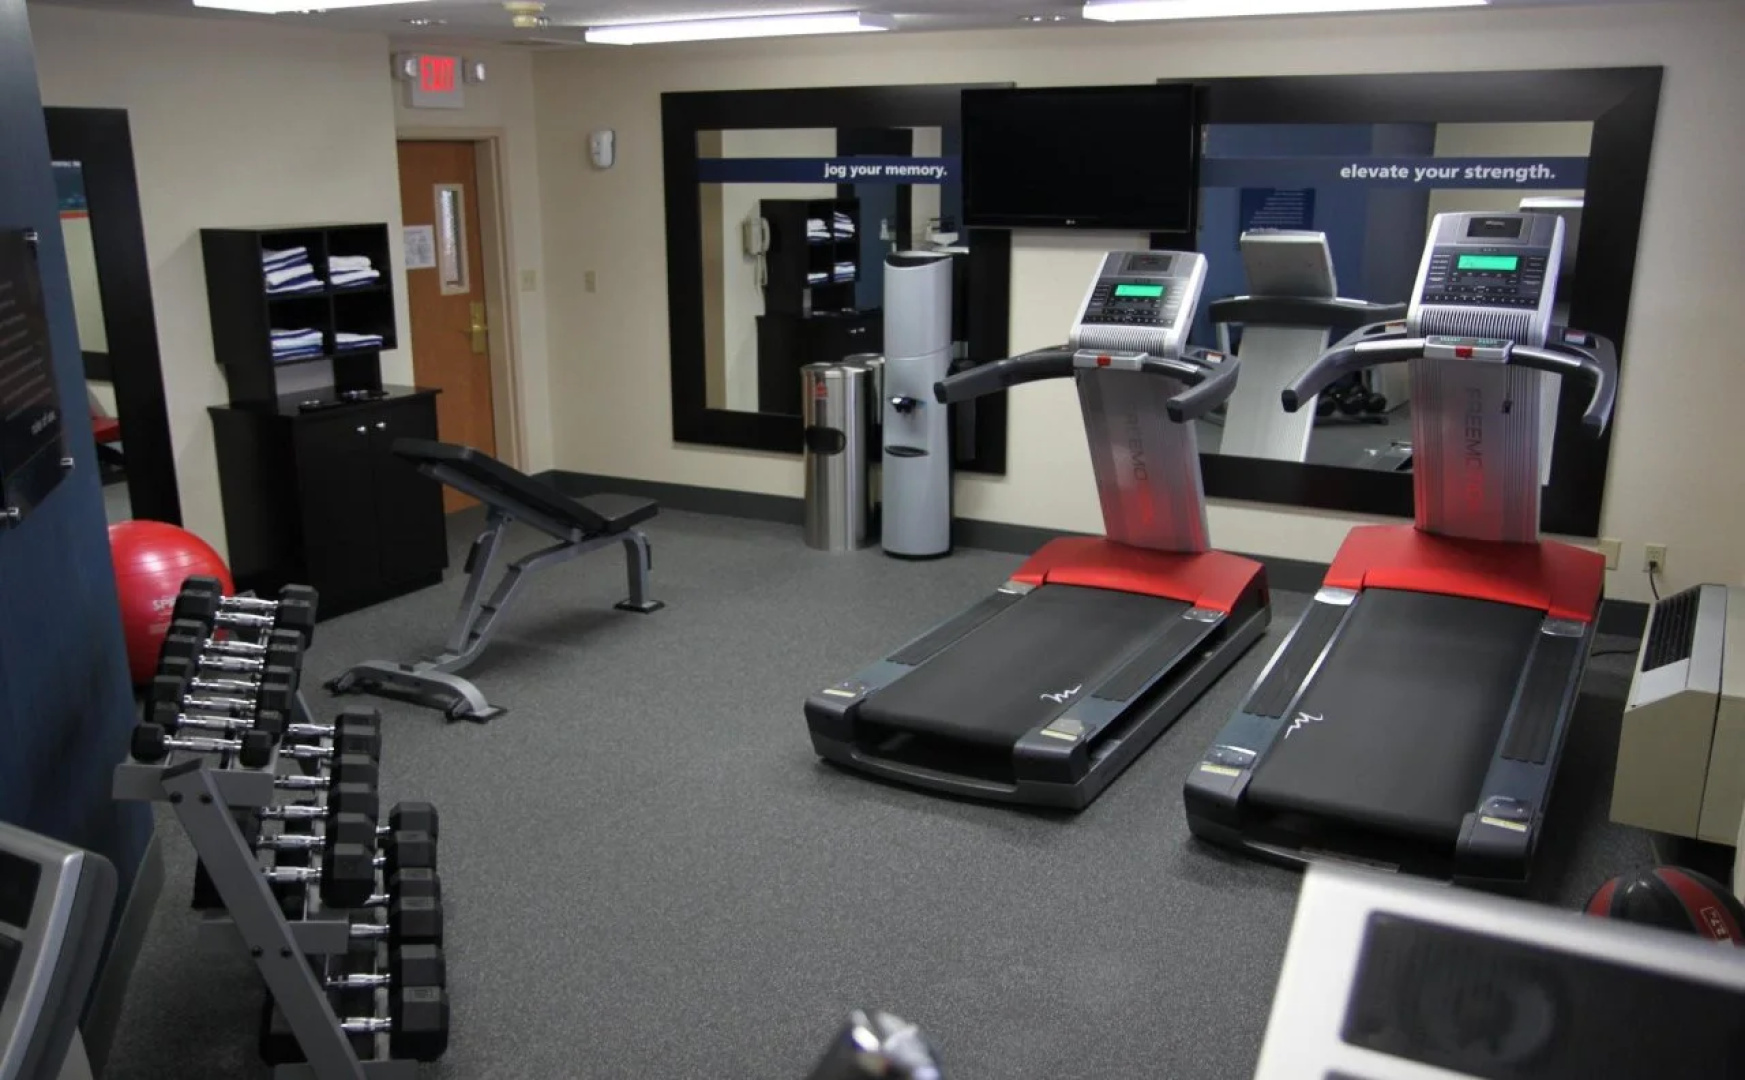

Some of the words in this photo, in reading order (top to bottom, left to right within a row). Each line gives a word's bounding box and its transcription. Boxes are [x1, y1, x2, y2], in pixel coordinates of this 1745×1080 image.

[420, 55, 456, 91] EXIT
[824, 162, 846, 179] jog
[850, 165, 882, 178] your
[885, 165, 947, 179] memory.
[1340, 164, 1409, 179] elevate
[1414, 166, 1460, 182] your
[1464, 164, 1555, 182] strength.
